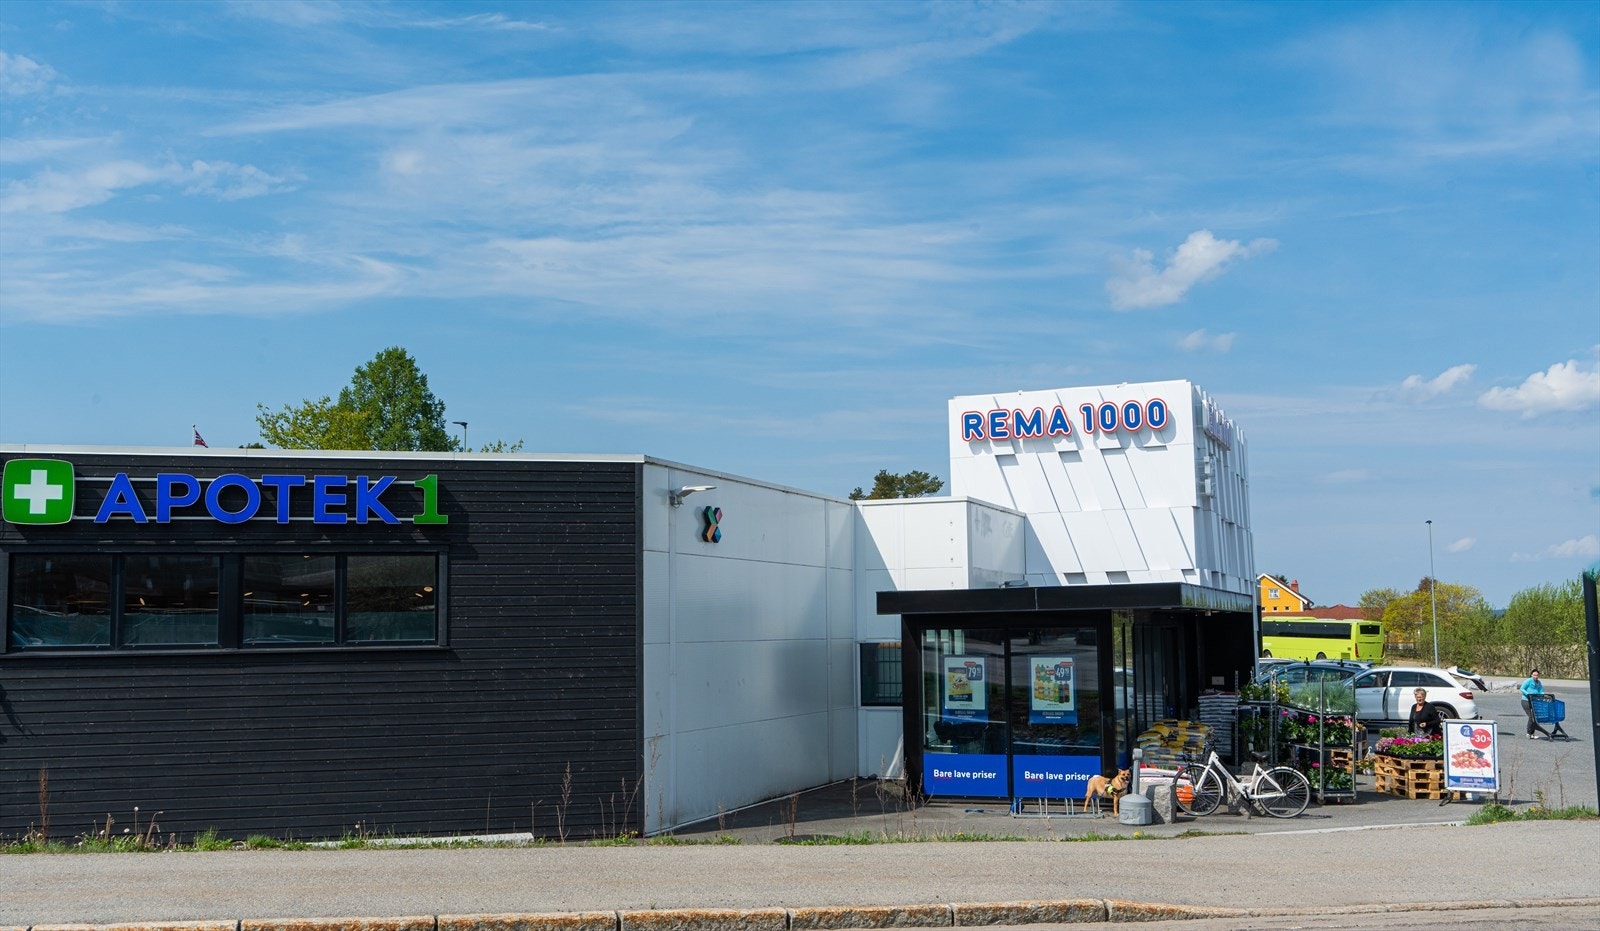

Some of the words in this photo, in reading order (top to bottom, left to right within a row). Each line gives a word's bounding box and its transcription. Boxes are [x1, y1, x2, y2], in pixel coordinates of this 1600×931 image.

[961, 405, 1073, 441] REMA
[1080, 398, 1169, 434] 1000
[94, 473, 401, 524] APOTEK
[413, 475, 449, 524] 1
[1056, 667, 1065, 678] 49
[933, 769, 952, 778] Bare
[954, 770, 971, 778] lave
[972, 770, 996, 780] priser
[1024, 771, 1044, 780] Bare
[1045, 771, 1063, 780] lave
[1065, 771, 1090, 782] priser
